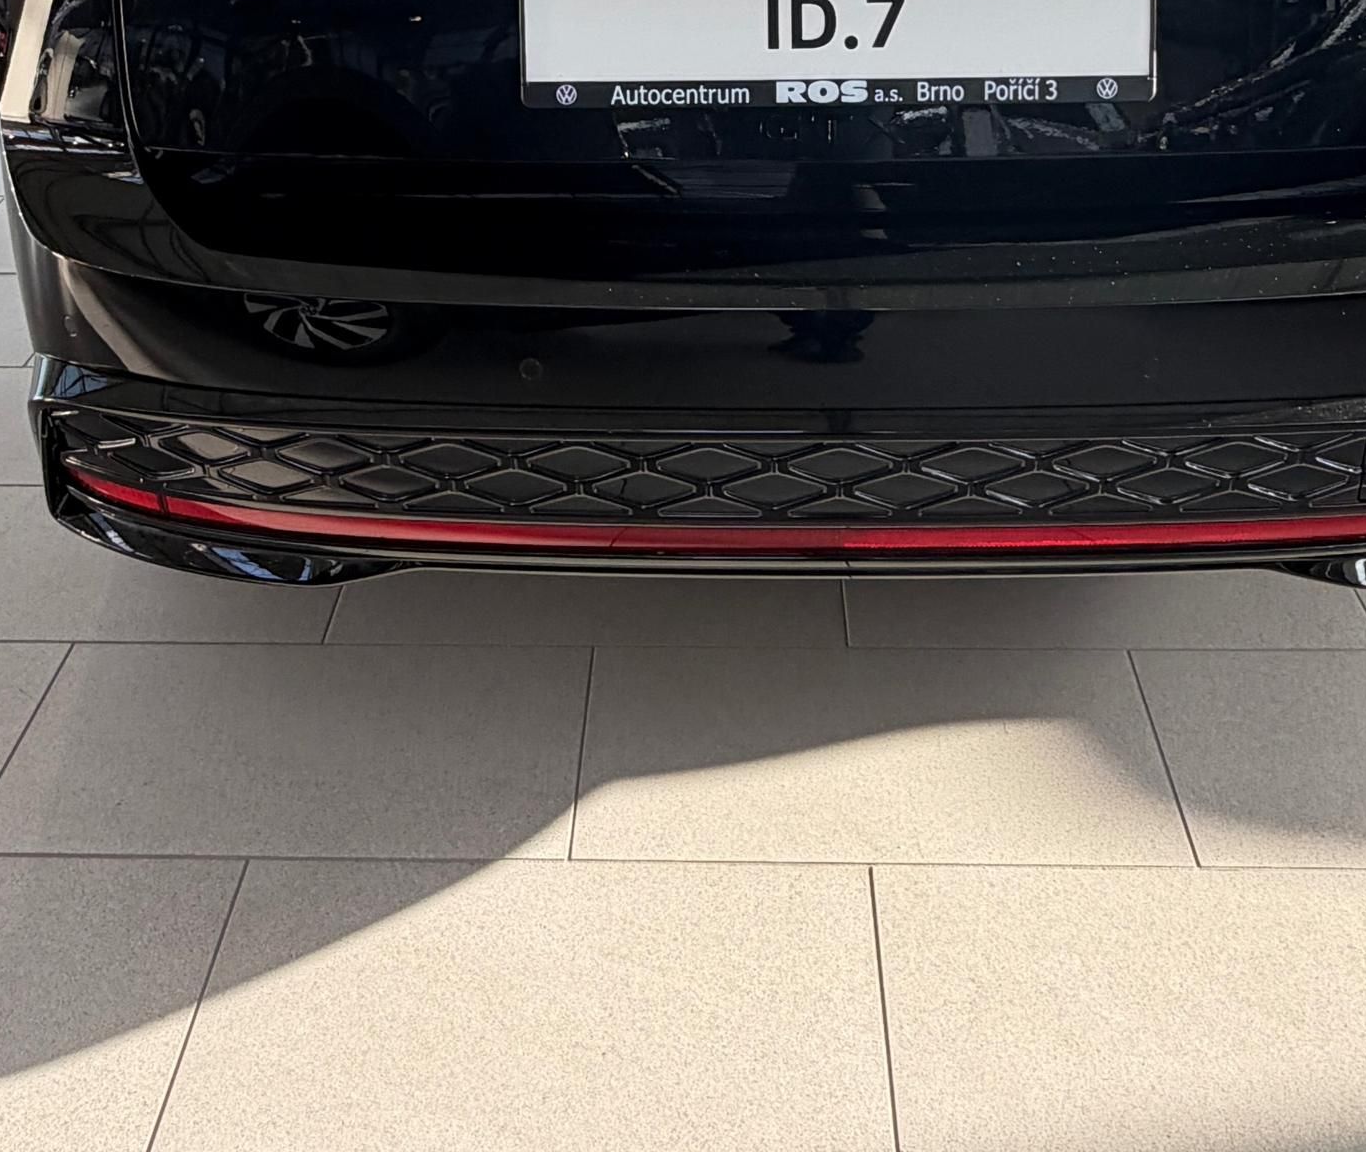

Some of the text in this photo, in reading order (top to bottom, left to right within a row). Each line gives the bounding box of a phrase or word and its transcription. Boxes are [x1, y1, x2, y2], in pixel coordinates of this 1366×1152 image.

[610, 84, 750, 106] Autocentrum
[775, 80, 869, 104] ROS
[874, 88, 904, 103] a.s.
[916, 81, 965, 102] Brno
[984, 78, 1041, 102] Poříčí
[1045, 80, 1058, 101] 3
